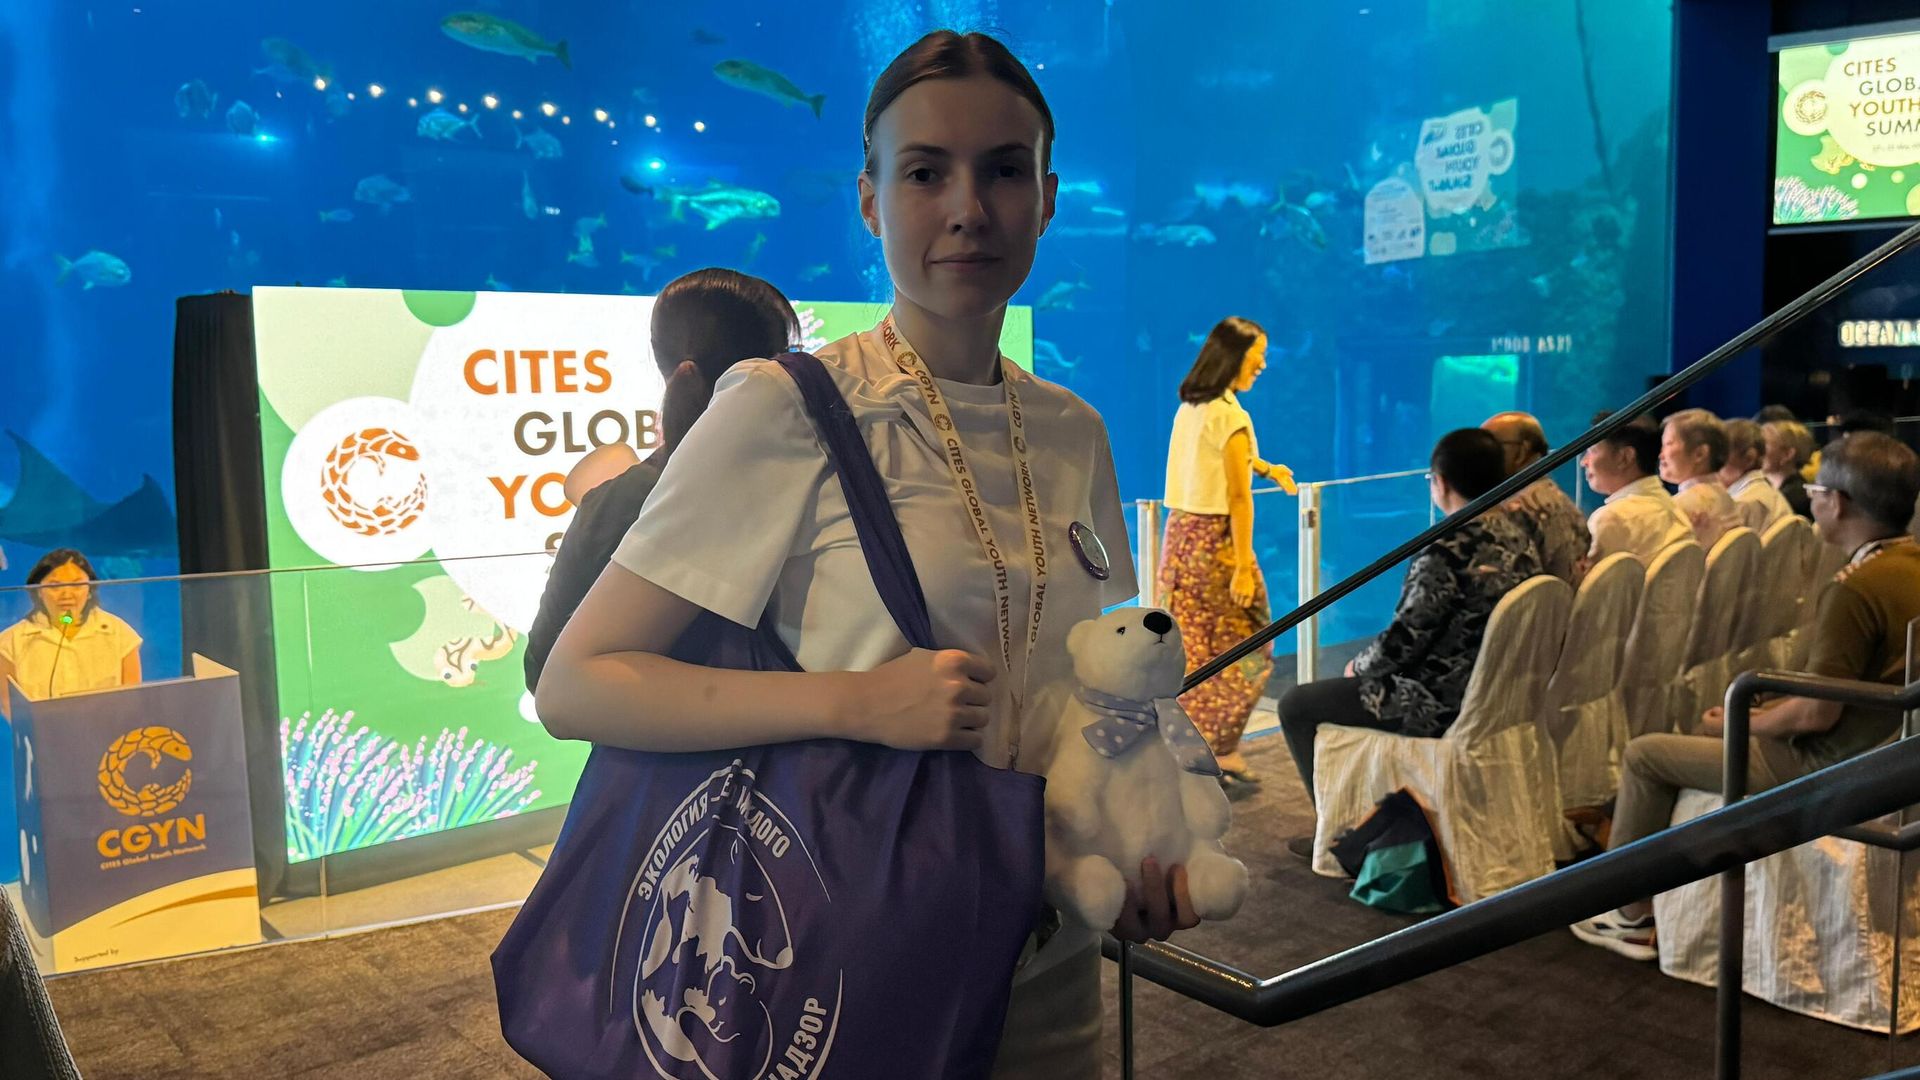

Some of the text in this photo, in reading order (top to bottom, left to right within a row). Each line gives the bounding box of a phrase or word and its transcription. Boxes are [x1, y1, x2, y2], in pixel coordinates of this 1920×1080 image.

[1844, 57, 1896, 76] CITES
[1859, 77, 1920, 95] GLOB
[1850, 97, 1920, 118] YOUTH
[464, 349, 612, 395] CITES
[914, 369, 940, 406] CGYN
[514, 409, 661, 456] GLOB
[1008, 392, 1021, 428] CGYN
[947, 438, 966, 474] CITES
[961, 478, 989, 535] GLOBAL
[985, 538, 1008, 591] YOUTH
[1019, 459, 1046, 643] GLOBAL YOUTH NETWORK
[97, 813, 206, 858] CGYN
[638, 792, 709, 900] ЭКОЛОГИЯ
